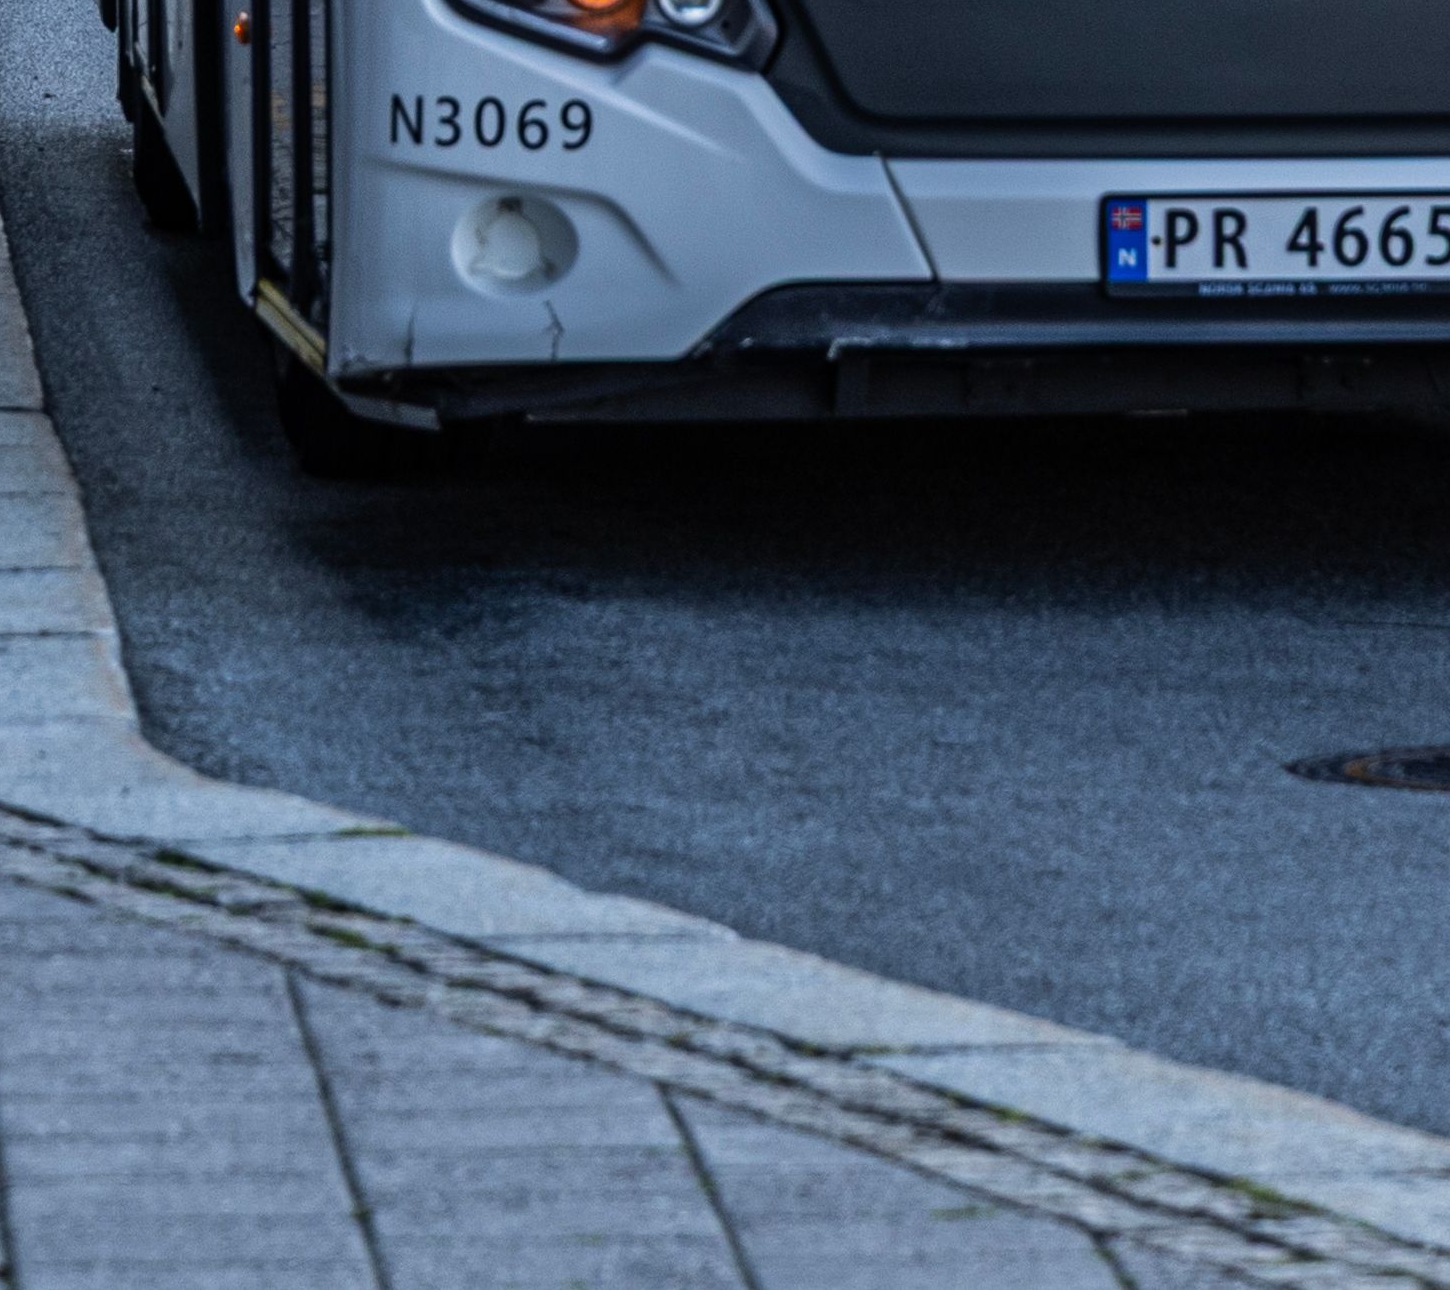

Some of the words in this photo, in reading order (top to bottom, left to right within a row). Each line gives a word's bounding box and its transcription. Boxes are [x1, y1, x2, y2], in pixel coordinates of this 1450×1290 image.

[389, 93, 594, 152] N3069
[1117, 247, 1138, 266] N
[1164, 207, 1248, 269] PR
